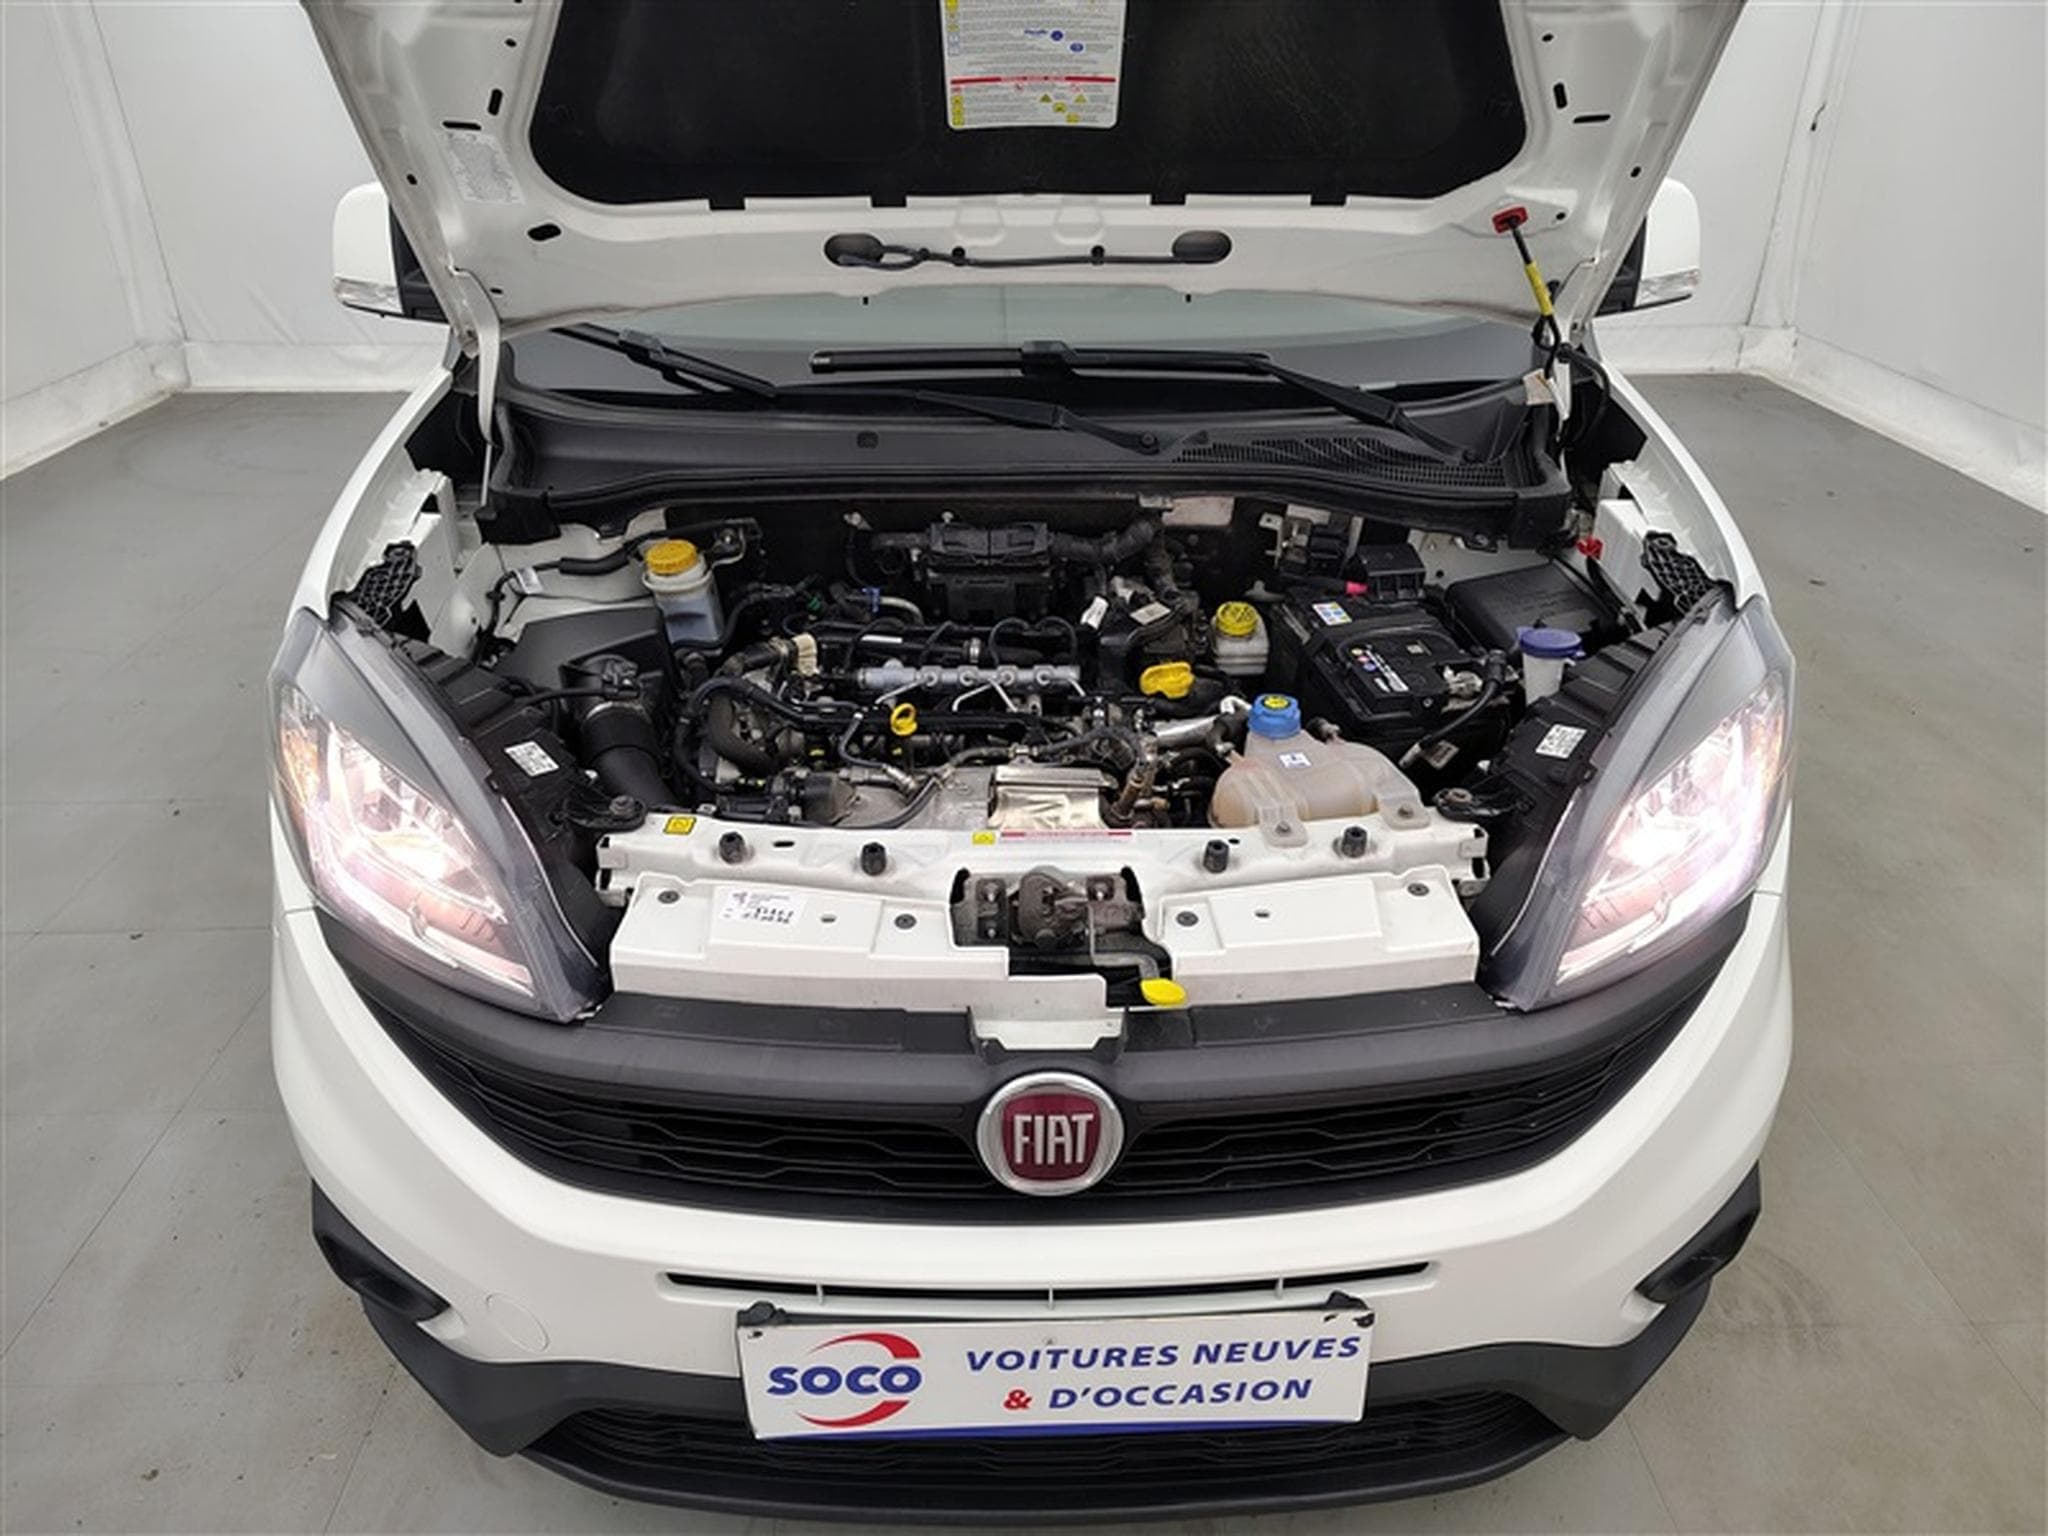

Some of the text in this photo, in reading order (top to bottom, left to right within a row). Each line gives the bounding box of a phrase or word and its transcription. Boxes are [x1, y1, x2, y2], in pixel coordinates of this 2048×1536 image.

[1013, 1113, 1094, 1165] FIAT
[966, 1335, 1361, 1372] VOITURES NEUVES
[766, 1364, 923, 1396] SOCO
[1002, 1378, 1313, 1411] & D'OCCASION
